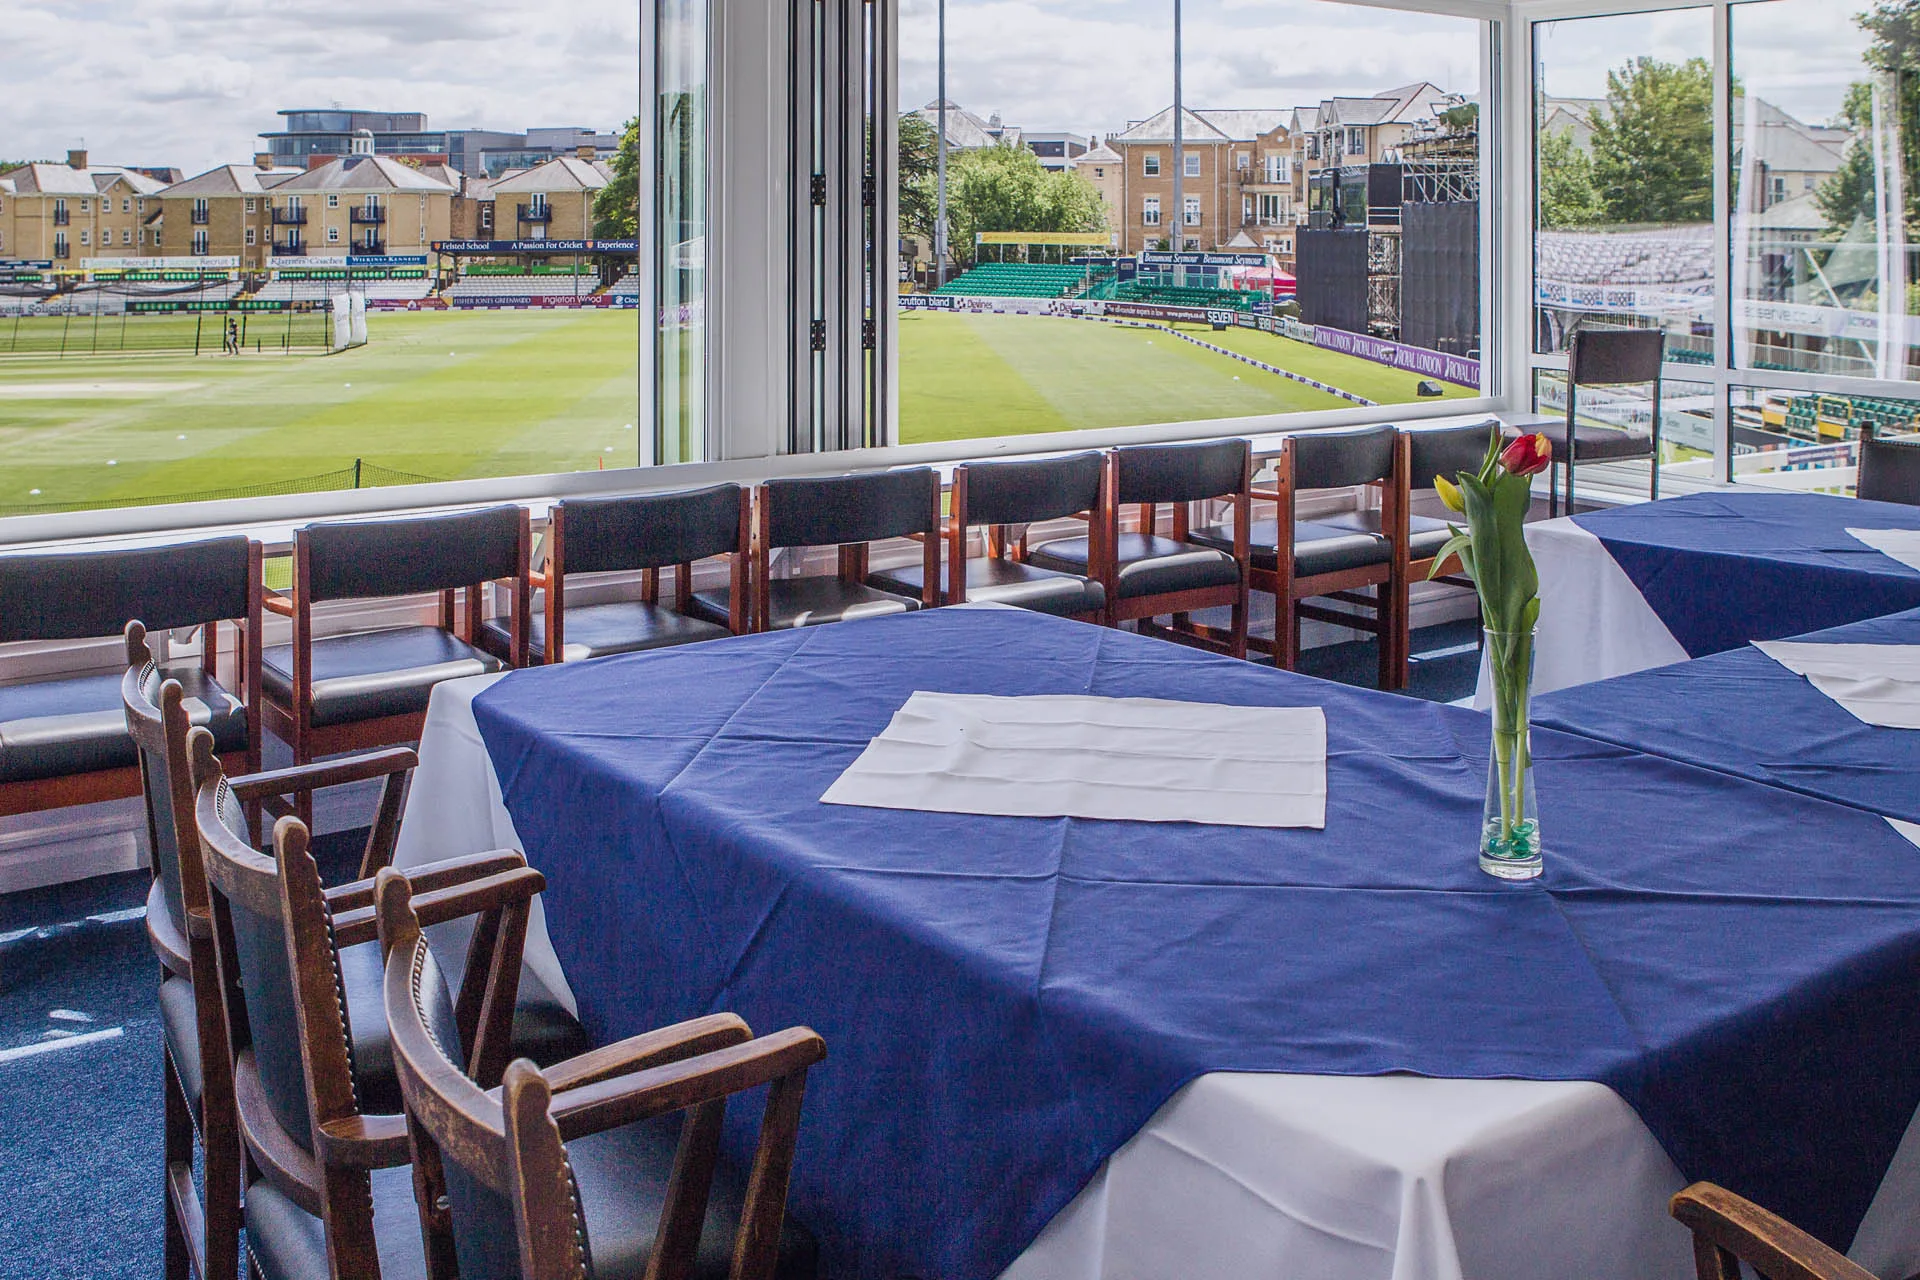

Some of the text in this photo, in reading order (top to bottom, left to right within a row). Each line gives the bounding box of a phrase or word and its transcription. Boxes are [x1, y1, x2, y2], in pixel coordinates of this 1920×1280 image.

[442, 242, 490, 250] Felsted School
[559, 241, 583, 249] Cricket
[597, 241, 634, 251] Experience
[1145, 252, 1198, 265] Beaumont Seymour
[1203, 253, 1263, 266] Beaumont Seymour
[454, 297, 531, 305] FISHER JONES GREENWOOD
[542, 295, 602, 305] Ingleton Wood
[898, 296, 950, 306] scrutton bland
[28, 304, 80, 314] Solicitors
[1207, 310, 1234, 325] SEVEN
[1399, 349, 1442, 376] ROYAL LONDON
[1450, 360, 1471, 382] ROYAL
